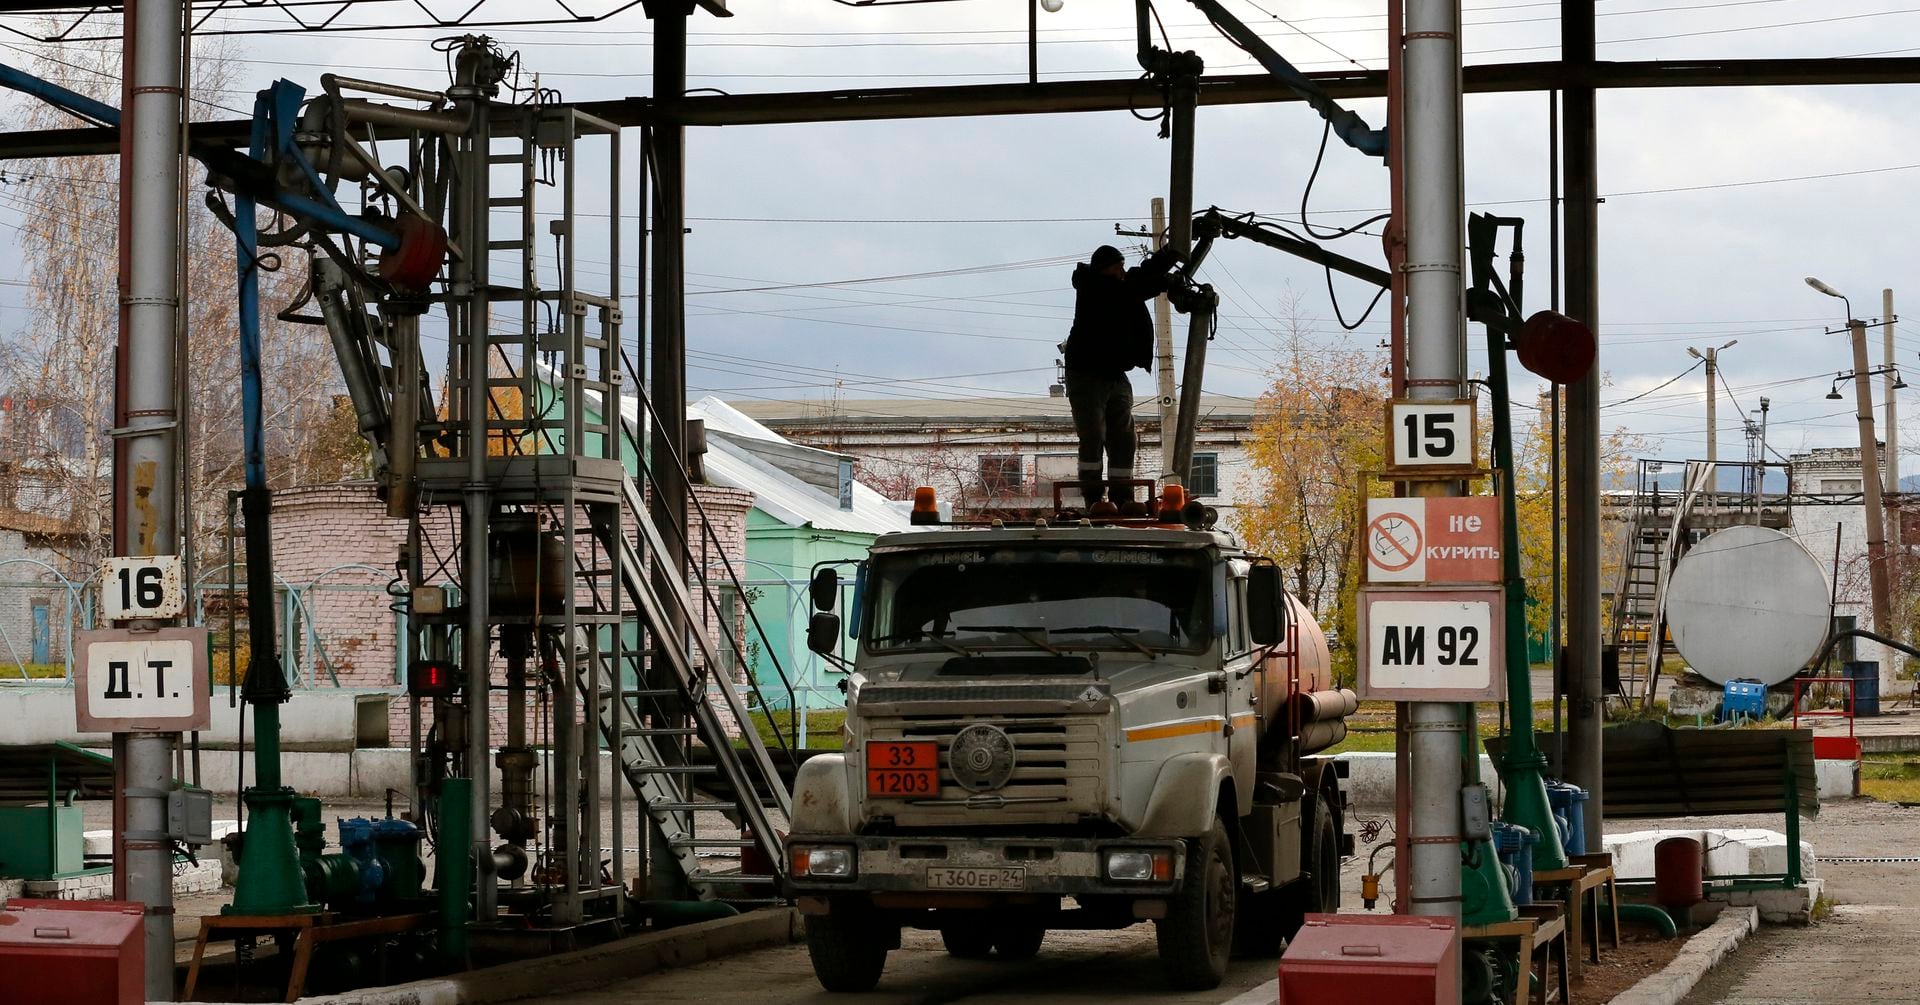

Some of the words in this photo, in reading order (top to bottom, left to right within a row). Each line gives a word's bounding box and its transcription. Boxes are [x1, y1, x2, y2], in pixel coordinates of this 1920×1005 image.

[1404, 413, 1455, 458] 15
[1426, 546, 1500, 560] КУРИТЬ
[118, 566, 164, 610] 16
[1381, 625, 1425, 666] АИ
[1437, 625, 1479, 666] 92
[104, 660, 179, 699] Д.Т.
[889, 746, 916, 766] 33
[876, 773, 929, 793] 1203
